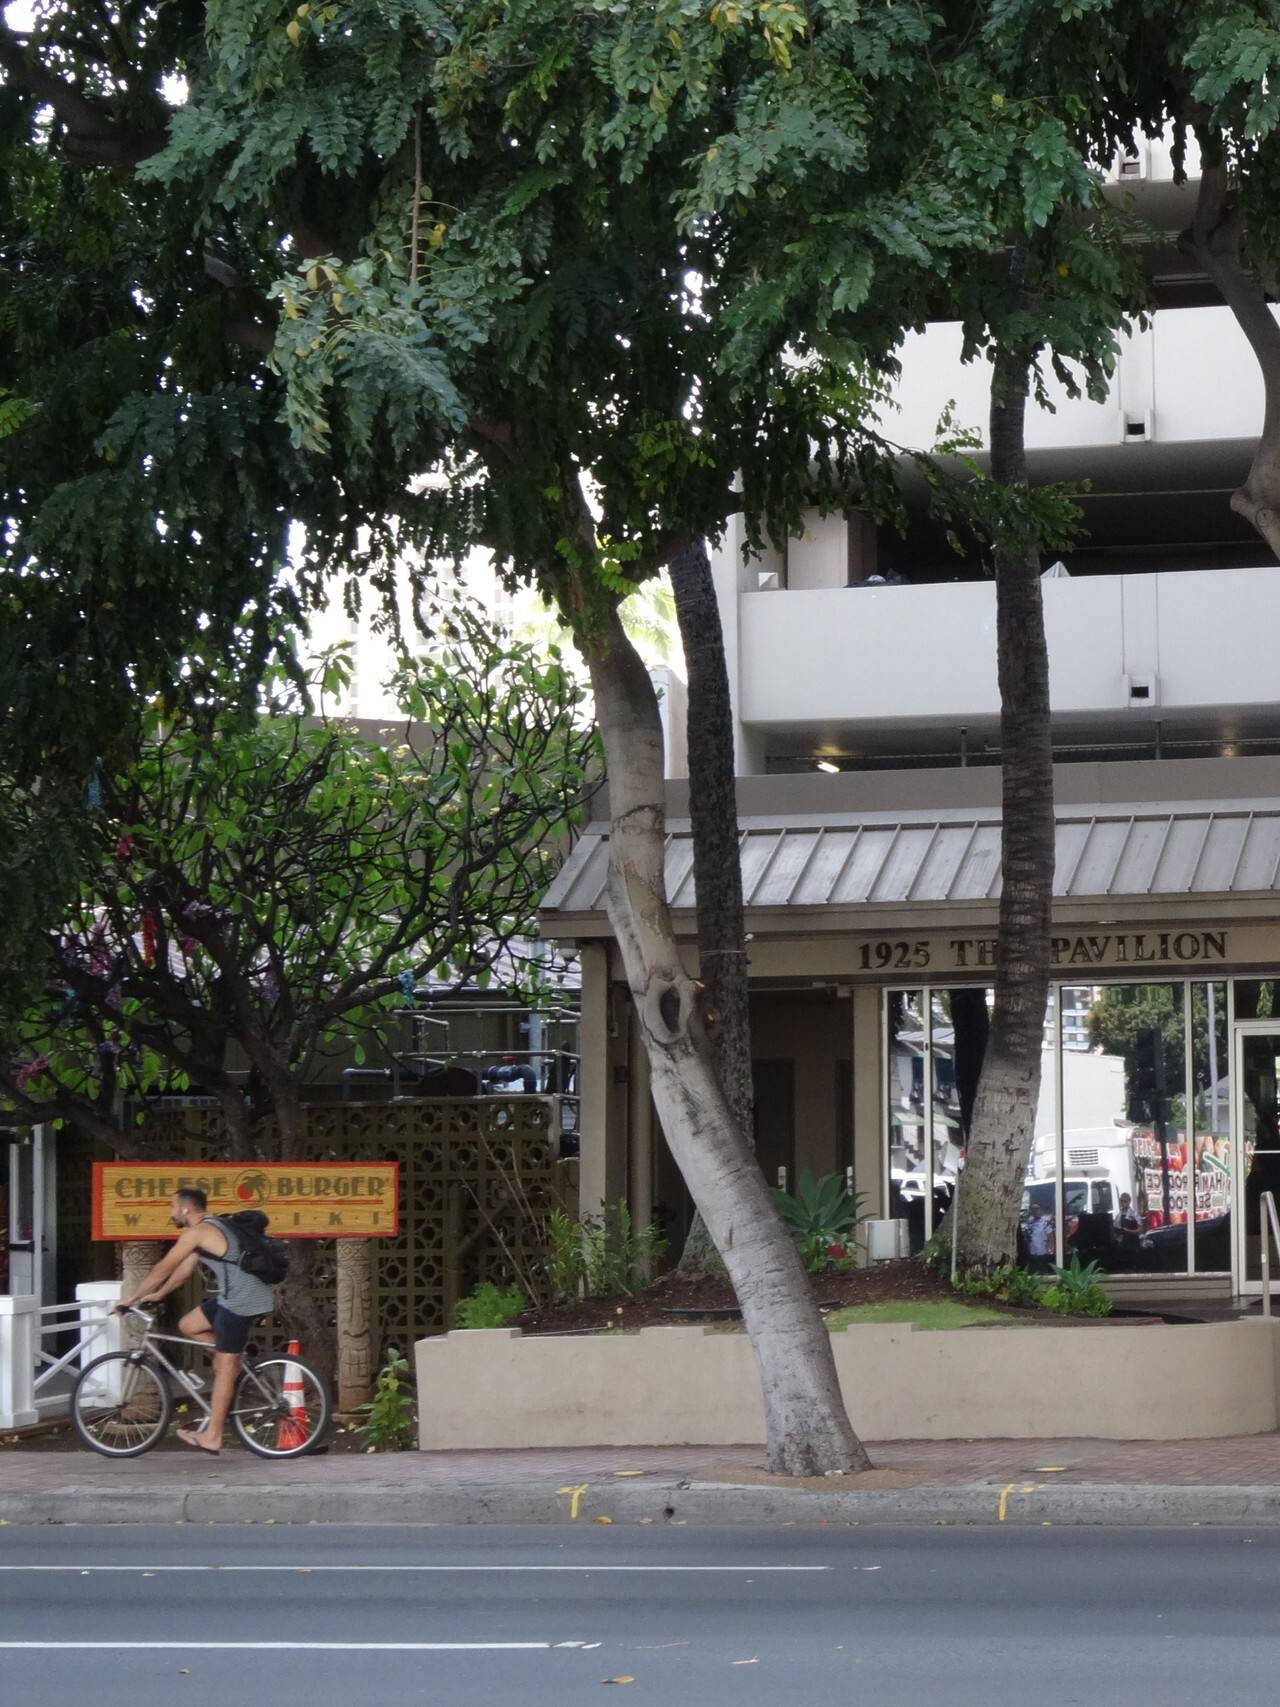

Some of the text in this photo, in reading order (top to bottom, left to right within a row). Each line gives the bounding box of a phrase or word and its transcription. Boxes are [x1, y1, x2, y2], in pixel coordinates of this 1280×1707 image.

[859, 931, 1228, 969] 1925 TH PAVILION
[277, 1175, 386, 1197] BURGER
